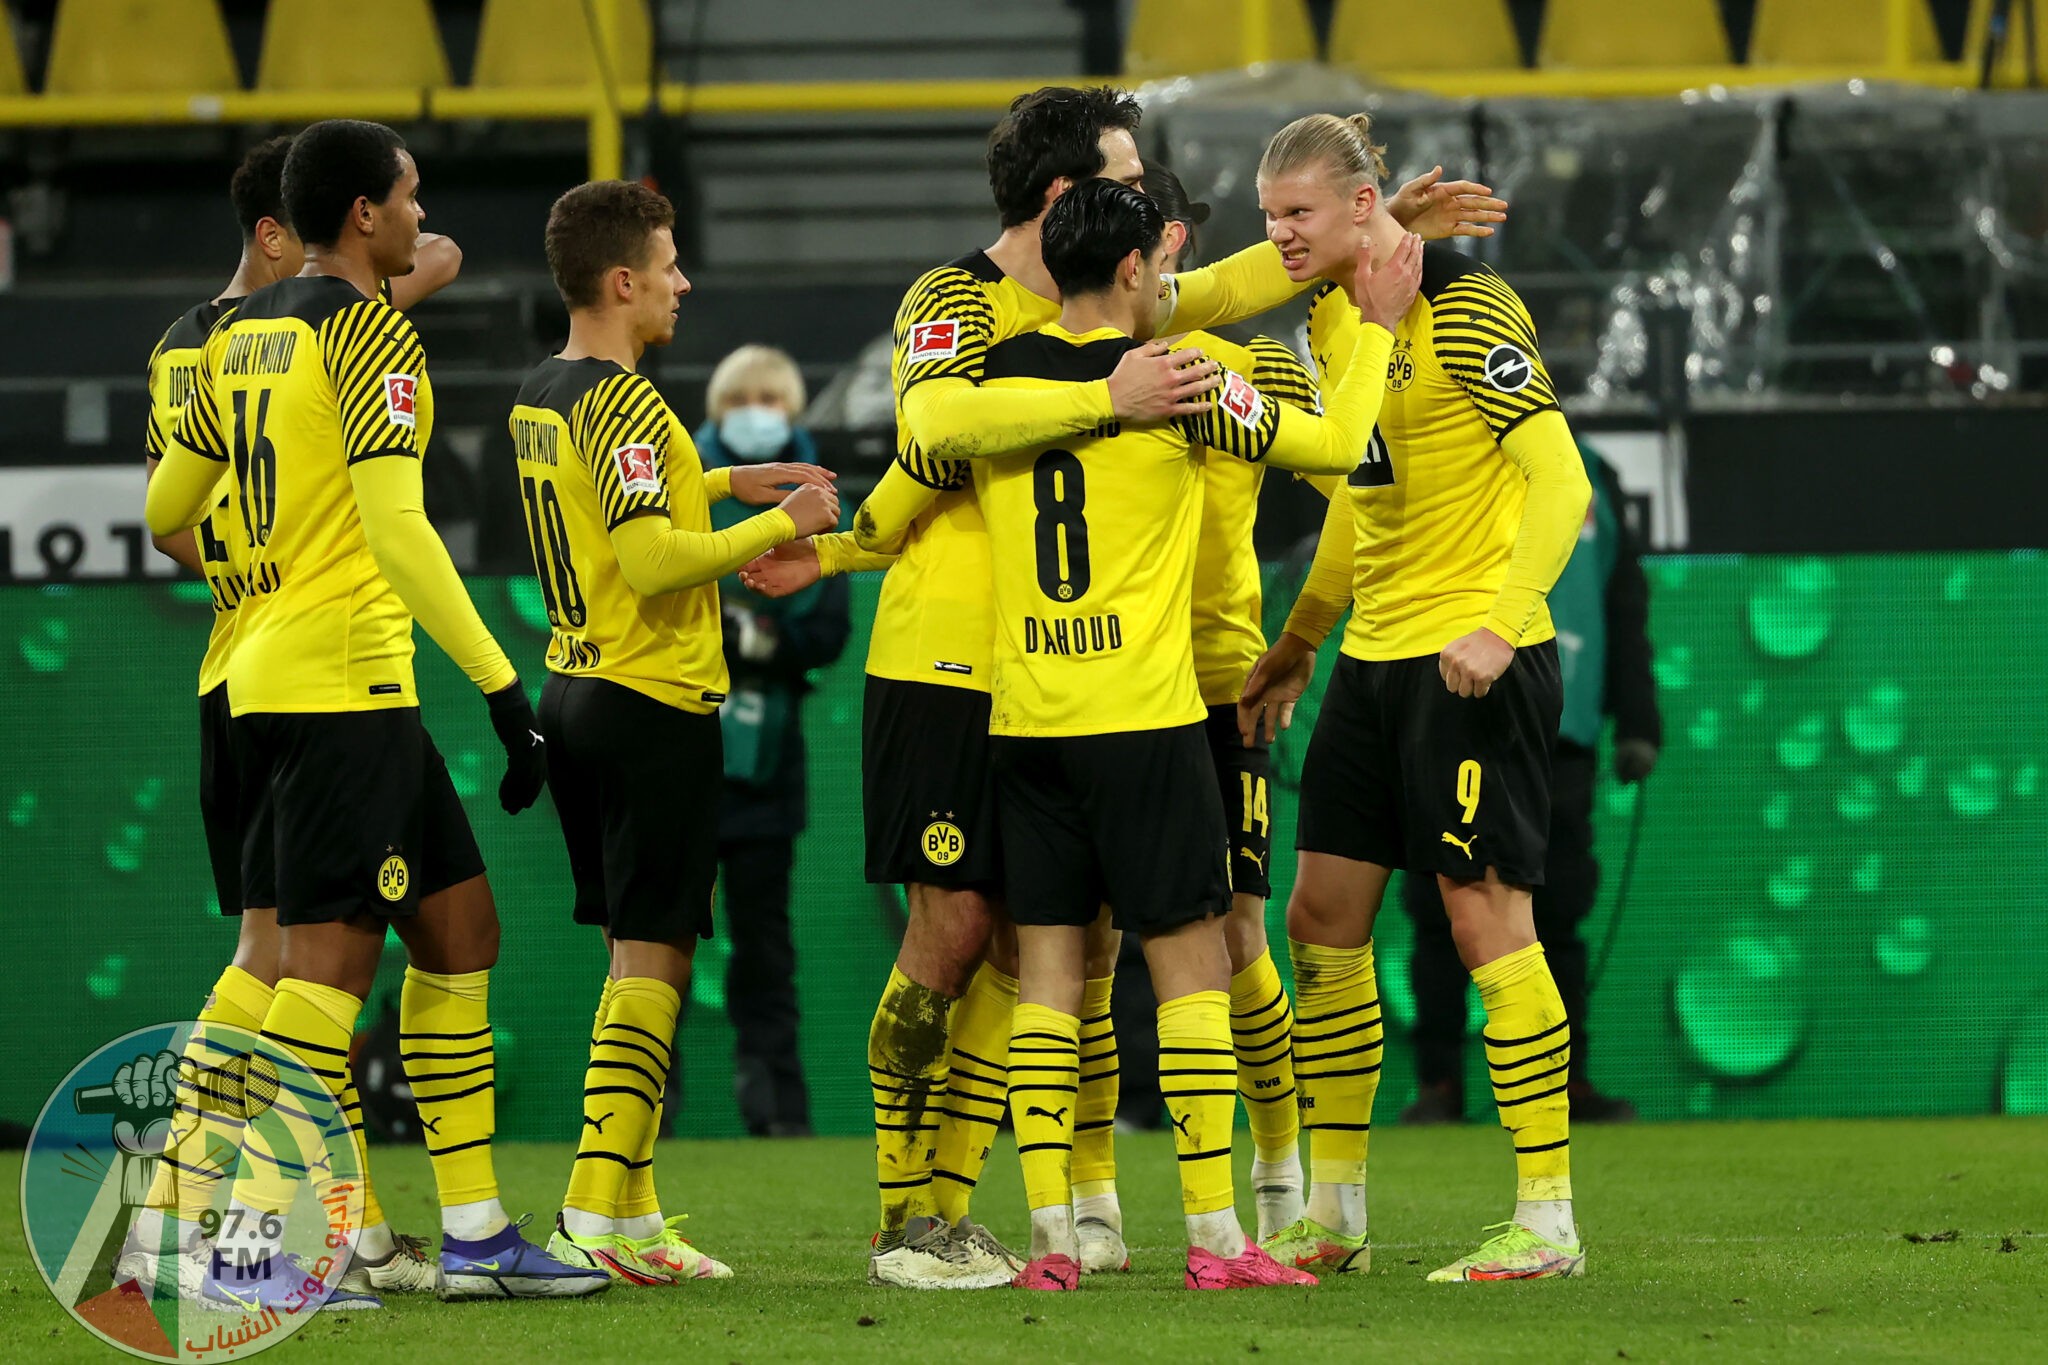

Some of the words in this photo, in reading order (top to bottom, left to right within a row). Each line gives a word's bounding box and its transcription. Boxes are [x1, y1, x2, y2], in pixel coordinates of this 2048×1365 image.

[223, 331, 297, 376] DORTMUND
[911, 350, 953, 361] BUNDESLIGA
[1386, 354, 1413, 380] BVB
[1391, 379, 1402, 389] 09
[231, 388, 277, 549] 16
[1032, 448, 1091, 603] 8
[523, 476, 587, 628] 10
[1024, 614, 1123, 656] DAHOUD
[1240, 771, 1269, 839] 14
[1456, 759, 1482, 824] 9
[928, 826, 960, 852] BVB
[937, 851, 949, 861] 09
[382, 860, 405, 887] BVB
[388, 886, 398, 896] 09
